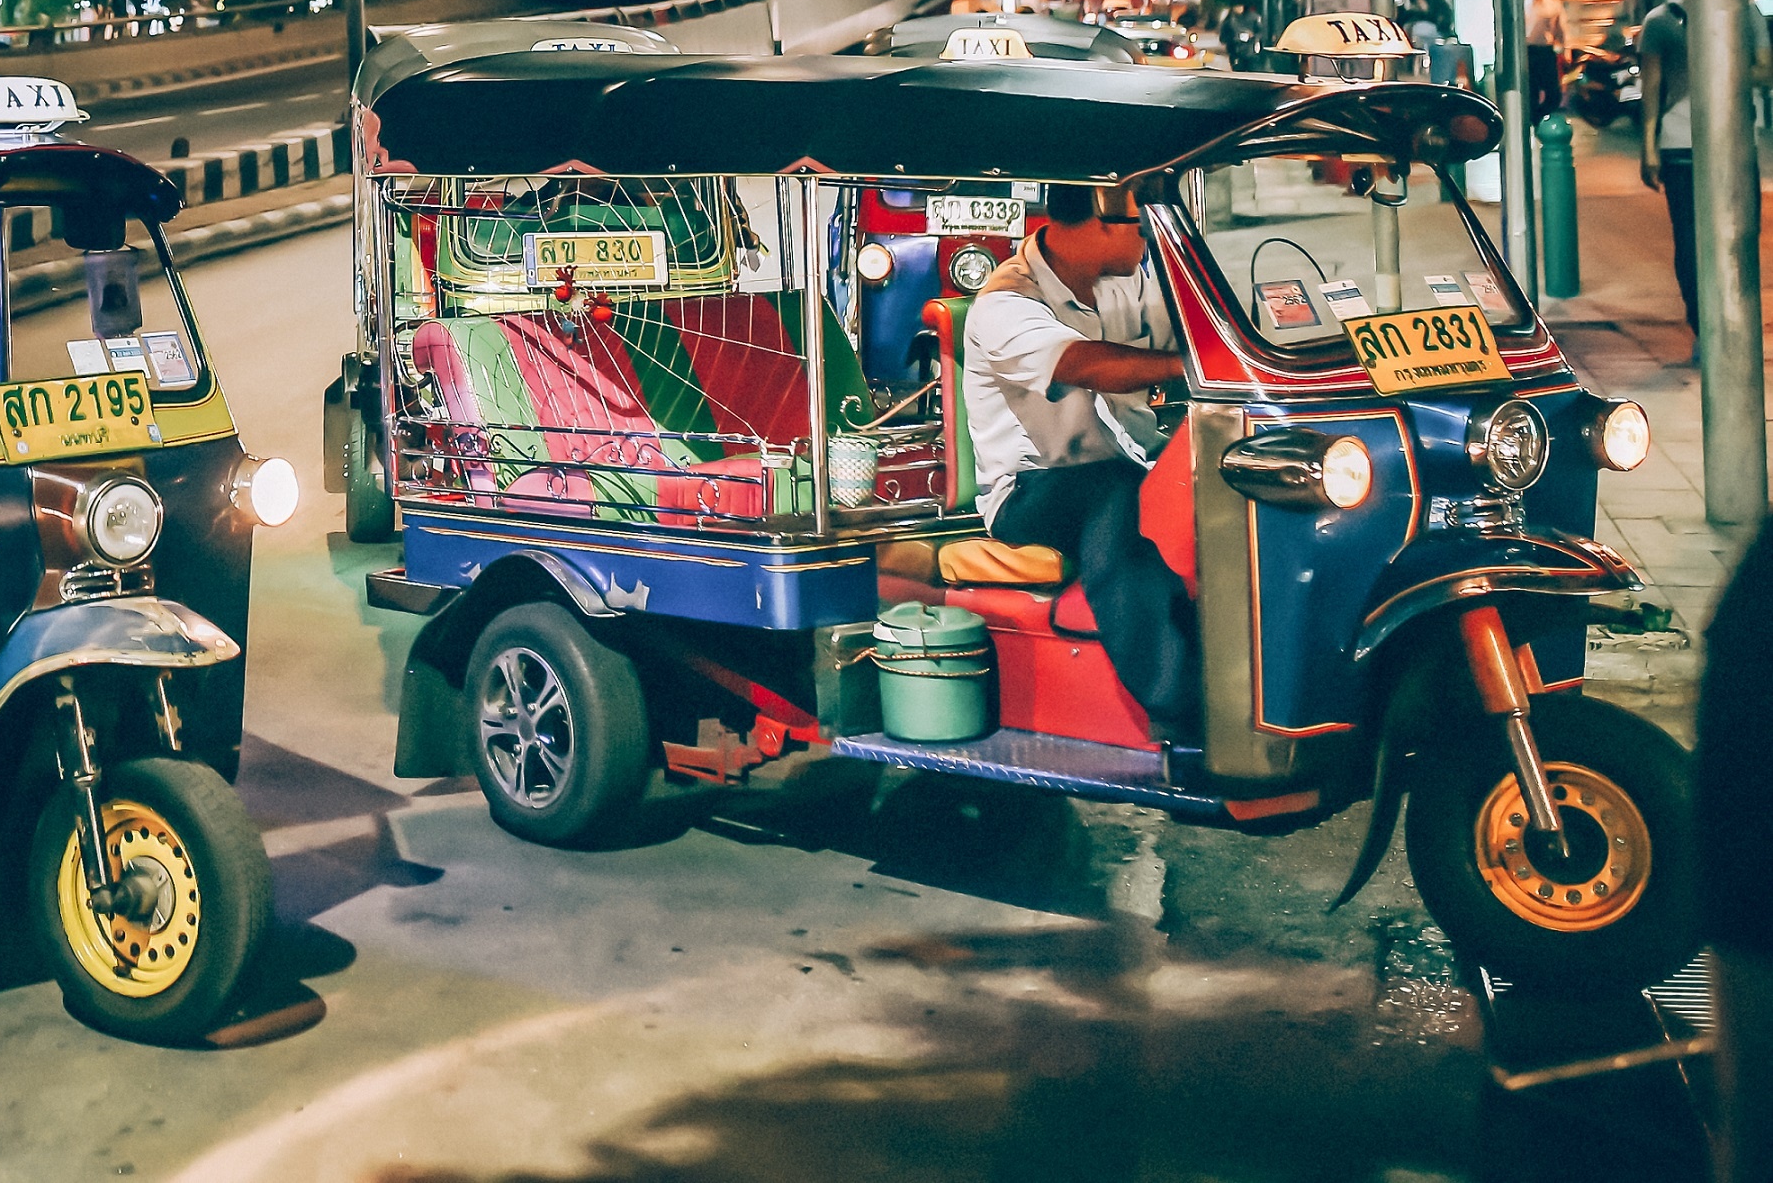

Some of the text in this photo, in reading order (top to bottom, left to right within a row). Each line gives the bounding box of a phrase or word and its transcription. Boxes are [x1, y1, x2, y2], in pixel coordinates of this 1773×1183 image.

[1326, 18, 1403, 44] TAXI
[957, 38, 1012, 56] TAXI
[969, 200, 1021, 222] 6339
[596, 239, 641, 262] 830
[1355, 311, 1489, 362] สก 2831
[2, 377, 145, 428] สก 2195
